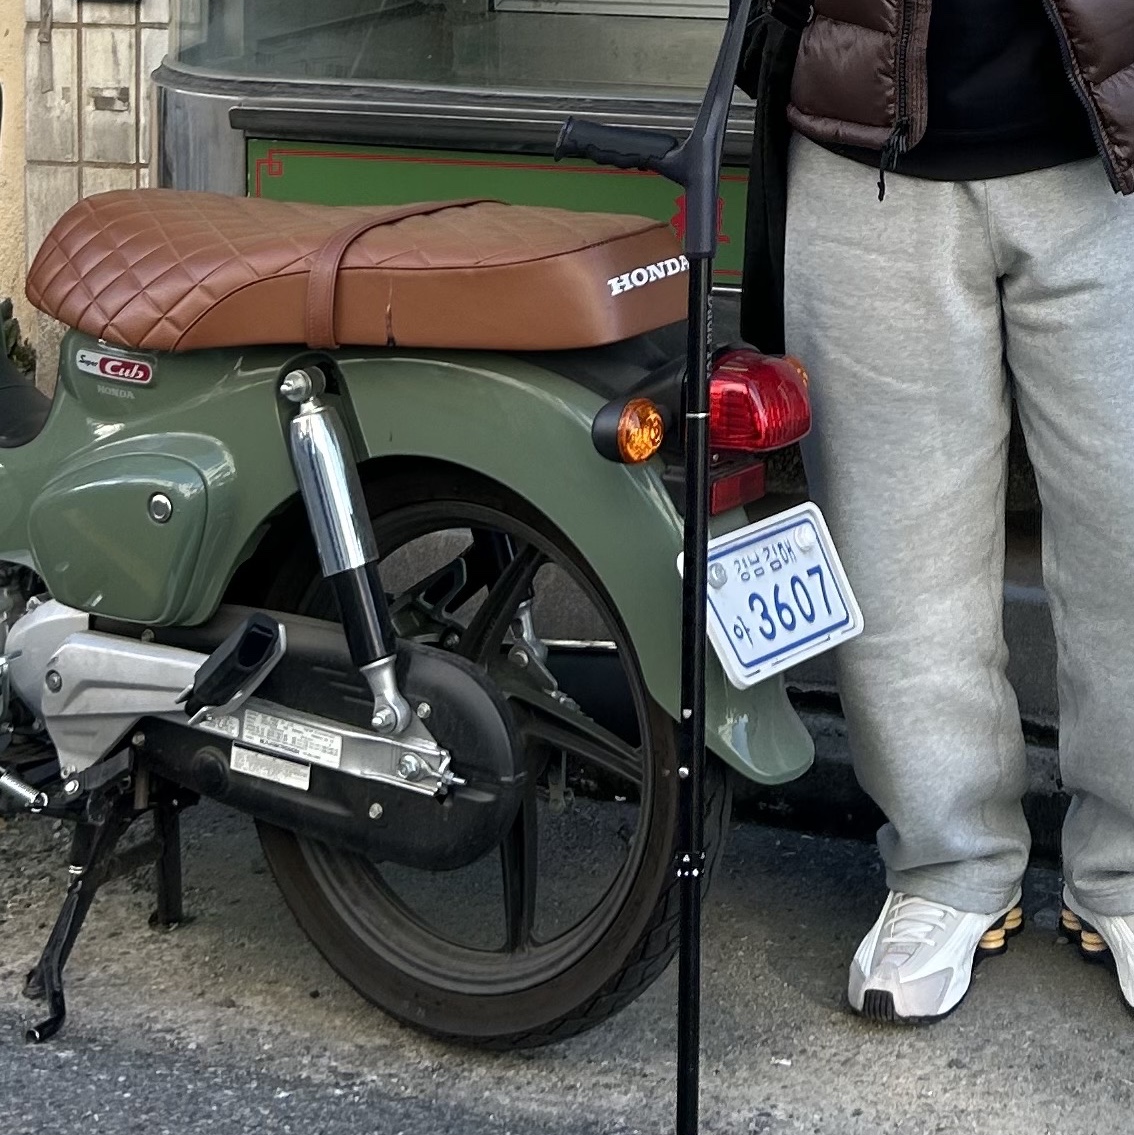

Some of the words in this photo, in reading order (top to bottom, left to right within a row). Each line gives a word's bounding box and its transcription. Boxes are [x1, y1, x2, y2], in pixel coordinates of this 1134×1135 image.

[606, 254, 690, 297] HONDA
[104, 360, 144, 379] Cub
[97, 384, 136, 400] HONDA
[748, 564, 832, 641] 3607
